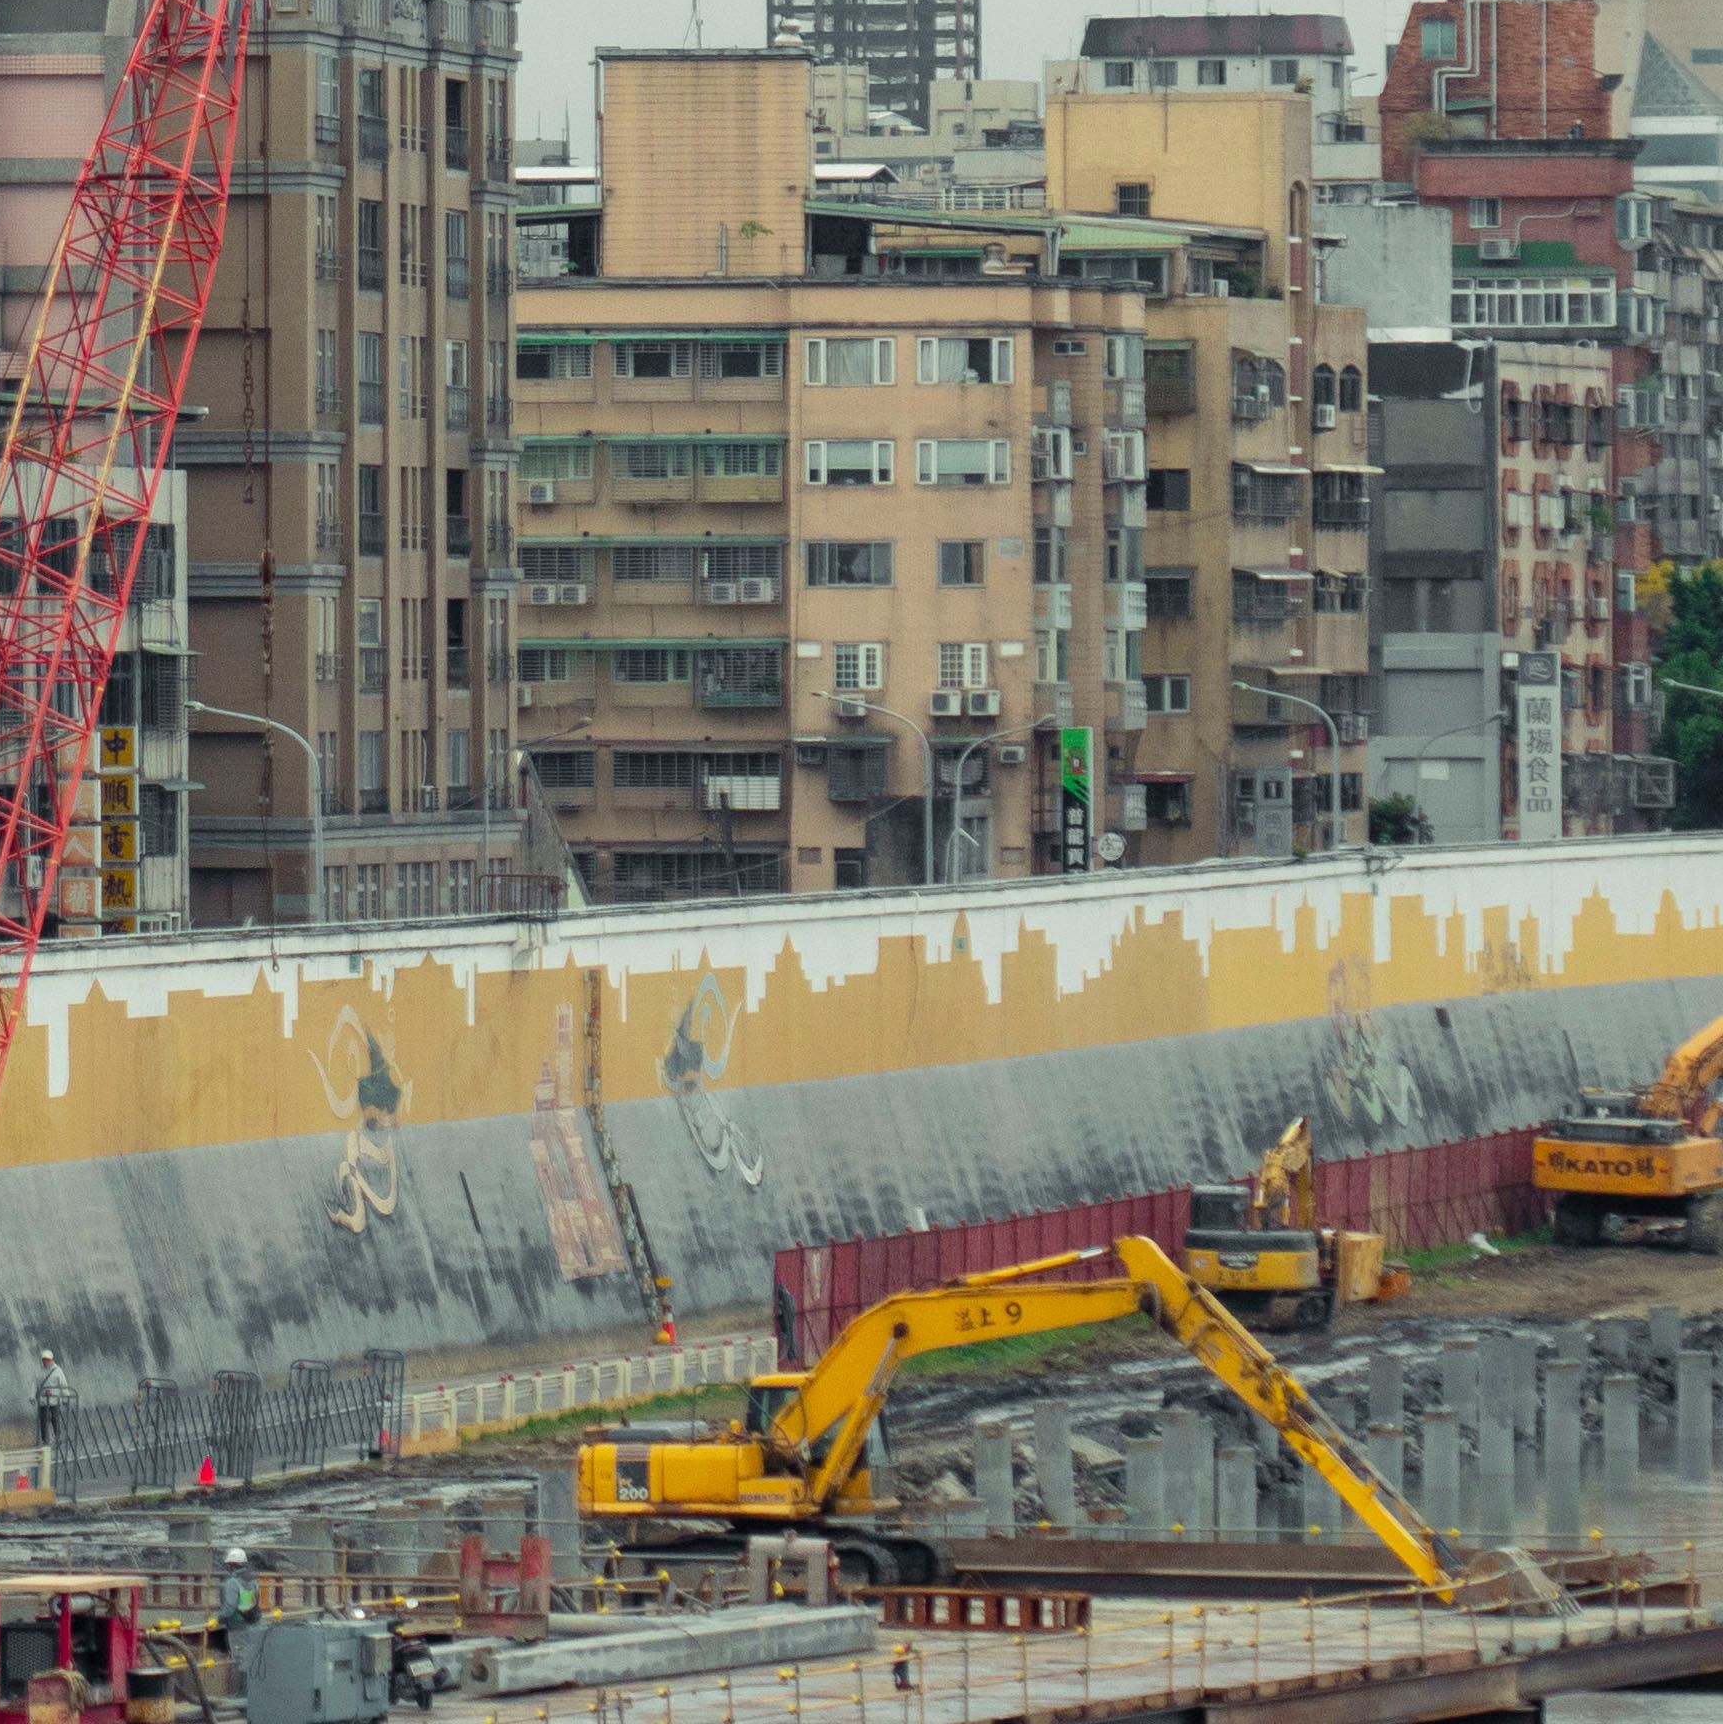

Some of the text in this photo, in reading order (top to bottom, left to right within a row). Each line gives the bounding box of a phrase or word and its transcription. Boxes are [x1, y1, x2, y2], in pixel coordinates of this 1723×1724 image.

[1565, 1157, 1632, 1176] KATO
[1005, 1301, 1022, 1325] 9
[619, 1488, 649, 1501] 200
